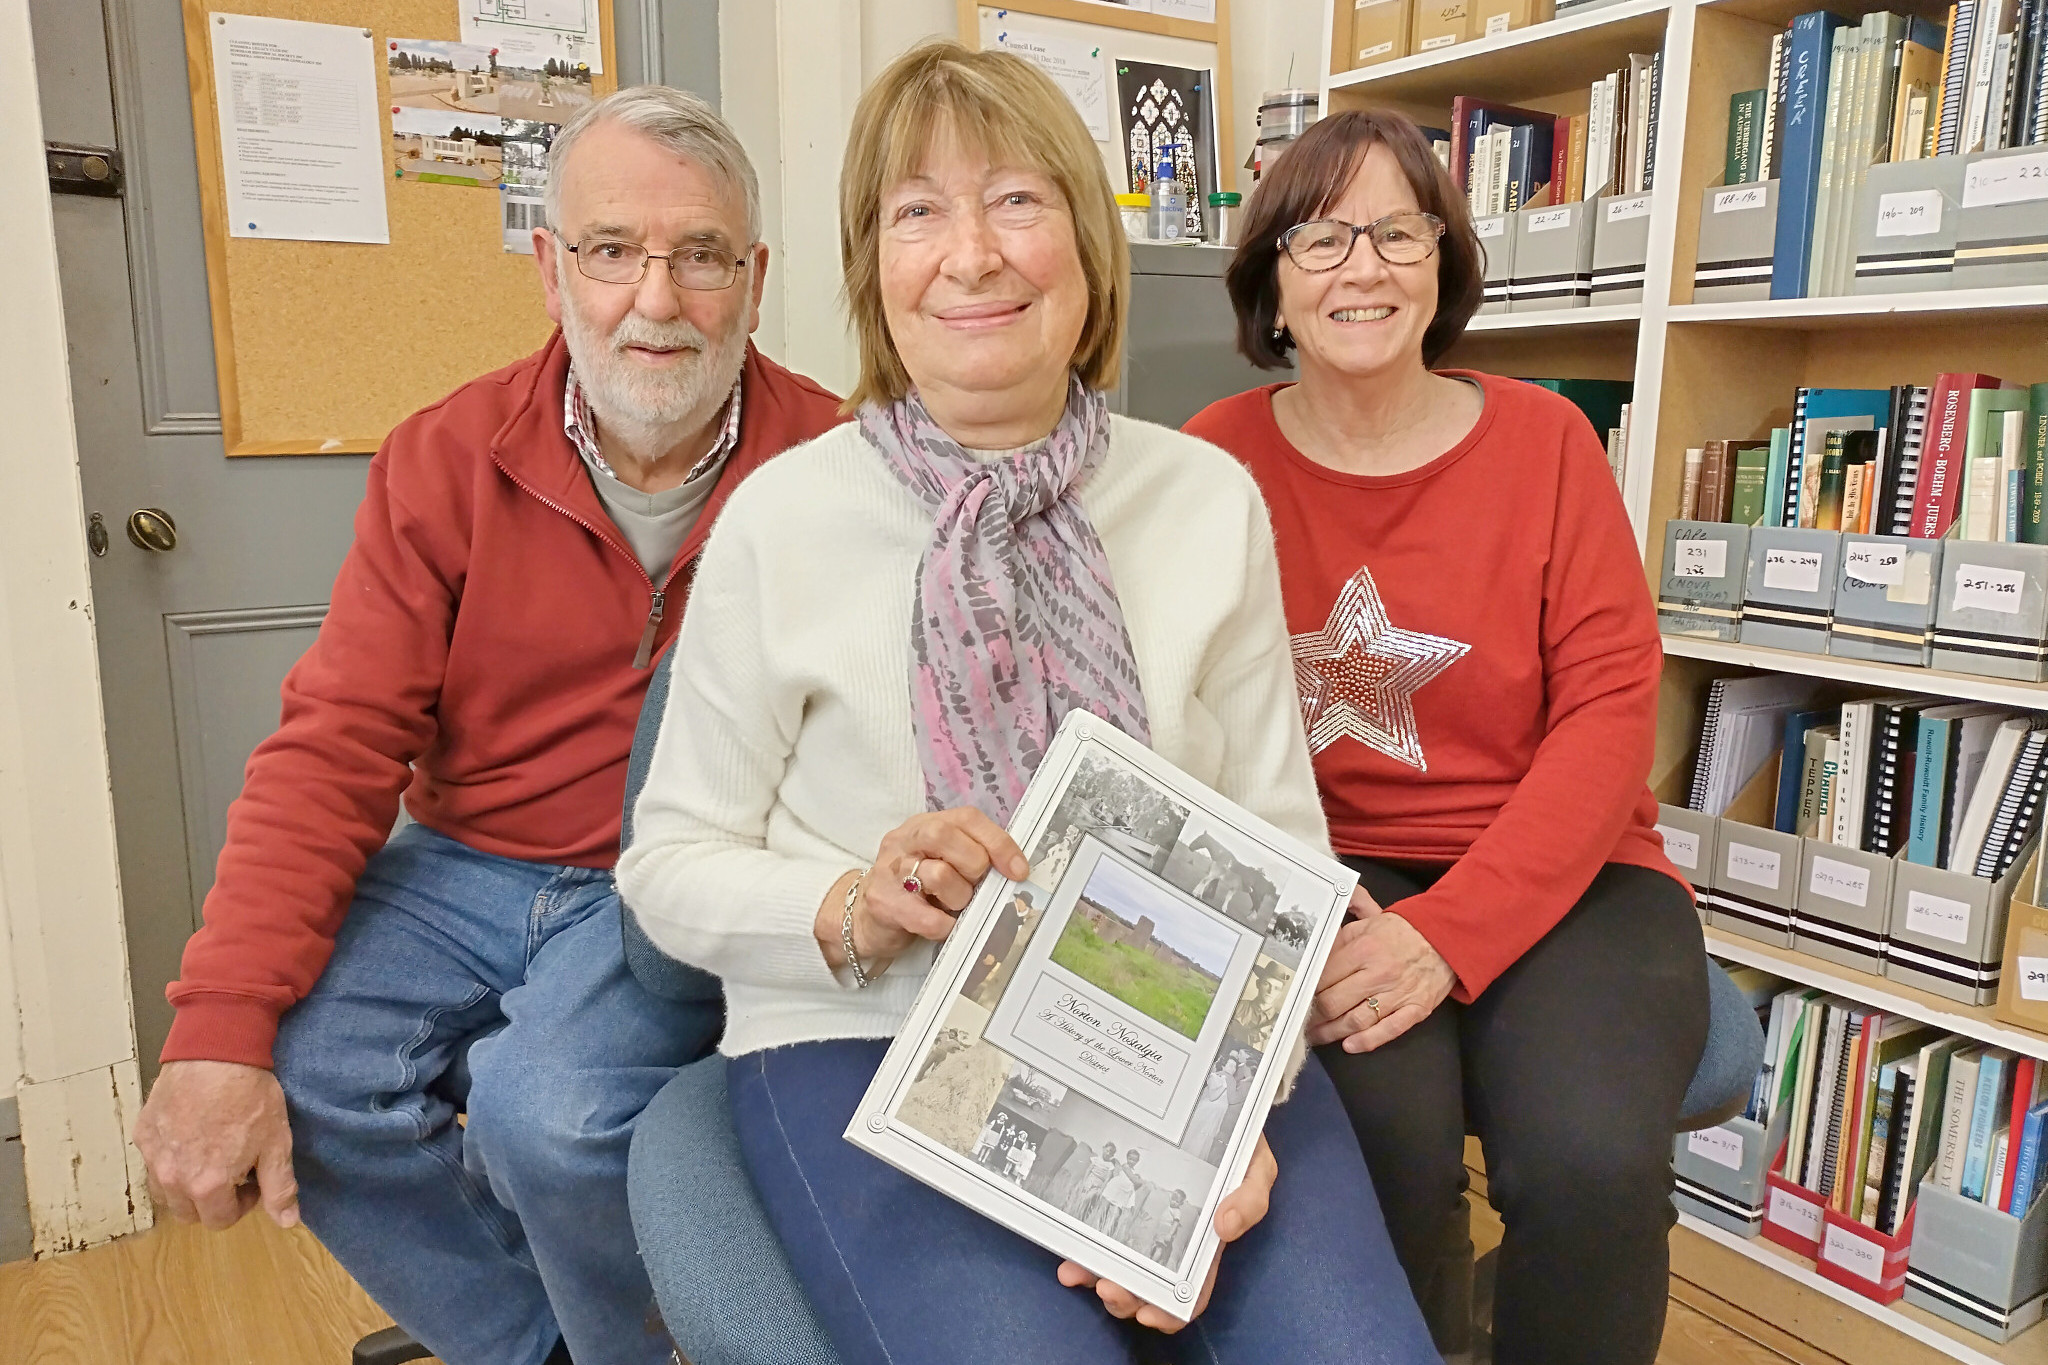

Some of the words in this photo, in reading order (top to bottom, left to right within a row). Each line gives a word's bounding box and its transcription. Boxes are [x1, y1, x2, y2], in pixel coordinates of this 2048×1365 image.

[1004, 41, 1029, 50] Council
[1029, 44, 1046, 53] Lease
[1041, 55, 1051, 64] Dec
[1790, 50, 1809, 126] CREEK
[1738, 102, 1746, 113] IN
[1734, 114, 1745, 160] AUSTRALIA
[1741, 119, 1751, 171] UEBERGANG
[1939, 389, 1960, 452] ROSENBERG
[2035, 415, 2048, 448] LINDNER
[1930, 459, 1948, 498] BOEHM
[1842, 711, 1852, 775] HORSHAM
[1803, 757, 1818, 818] TEPPER
[1840, 787, 1846, 803] IN
[1920, 789, 1930, 813] Family
[1915, 814, 1927, 842] History
[1057, 993, 1101, 1028] Norton
[1107, 1021, 1163, 1062] Nostalgia
[1038, 1008, 1055, 1021] A
[1054, 1016, 1083, 1042] History
[1093, 1039, 1106, 1052] the
[1106, 1046, 1133, 1067] Lower
[1134, 1061, 1164, 1085] Norton
[1079, 1050, 1110, 1073] District
[1953, 1079, 1965, 1104] THE
[1981, 1077, 1993, 1107] KEILOR
[1943, 1108, 1961, 1173] SOMERSET
[1974, 1107, 1987, 1149] PIONEERS
[2020, 1145, 2032, 1180] HISTORY
[2018, 1182, 2025, 1196] OF
